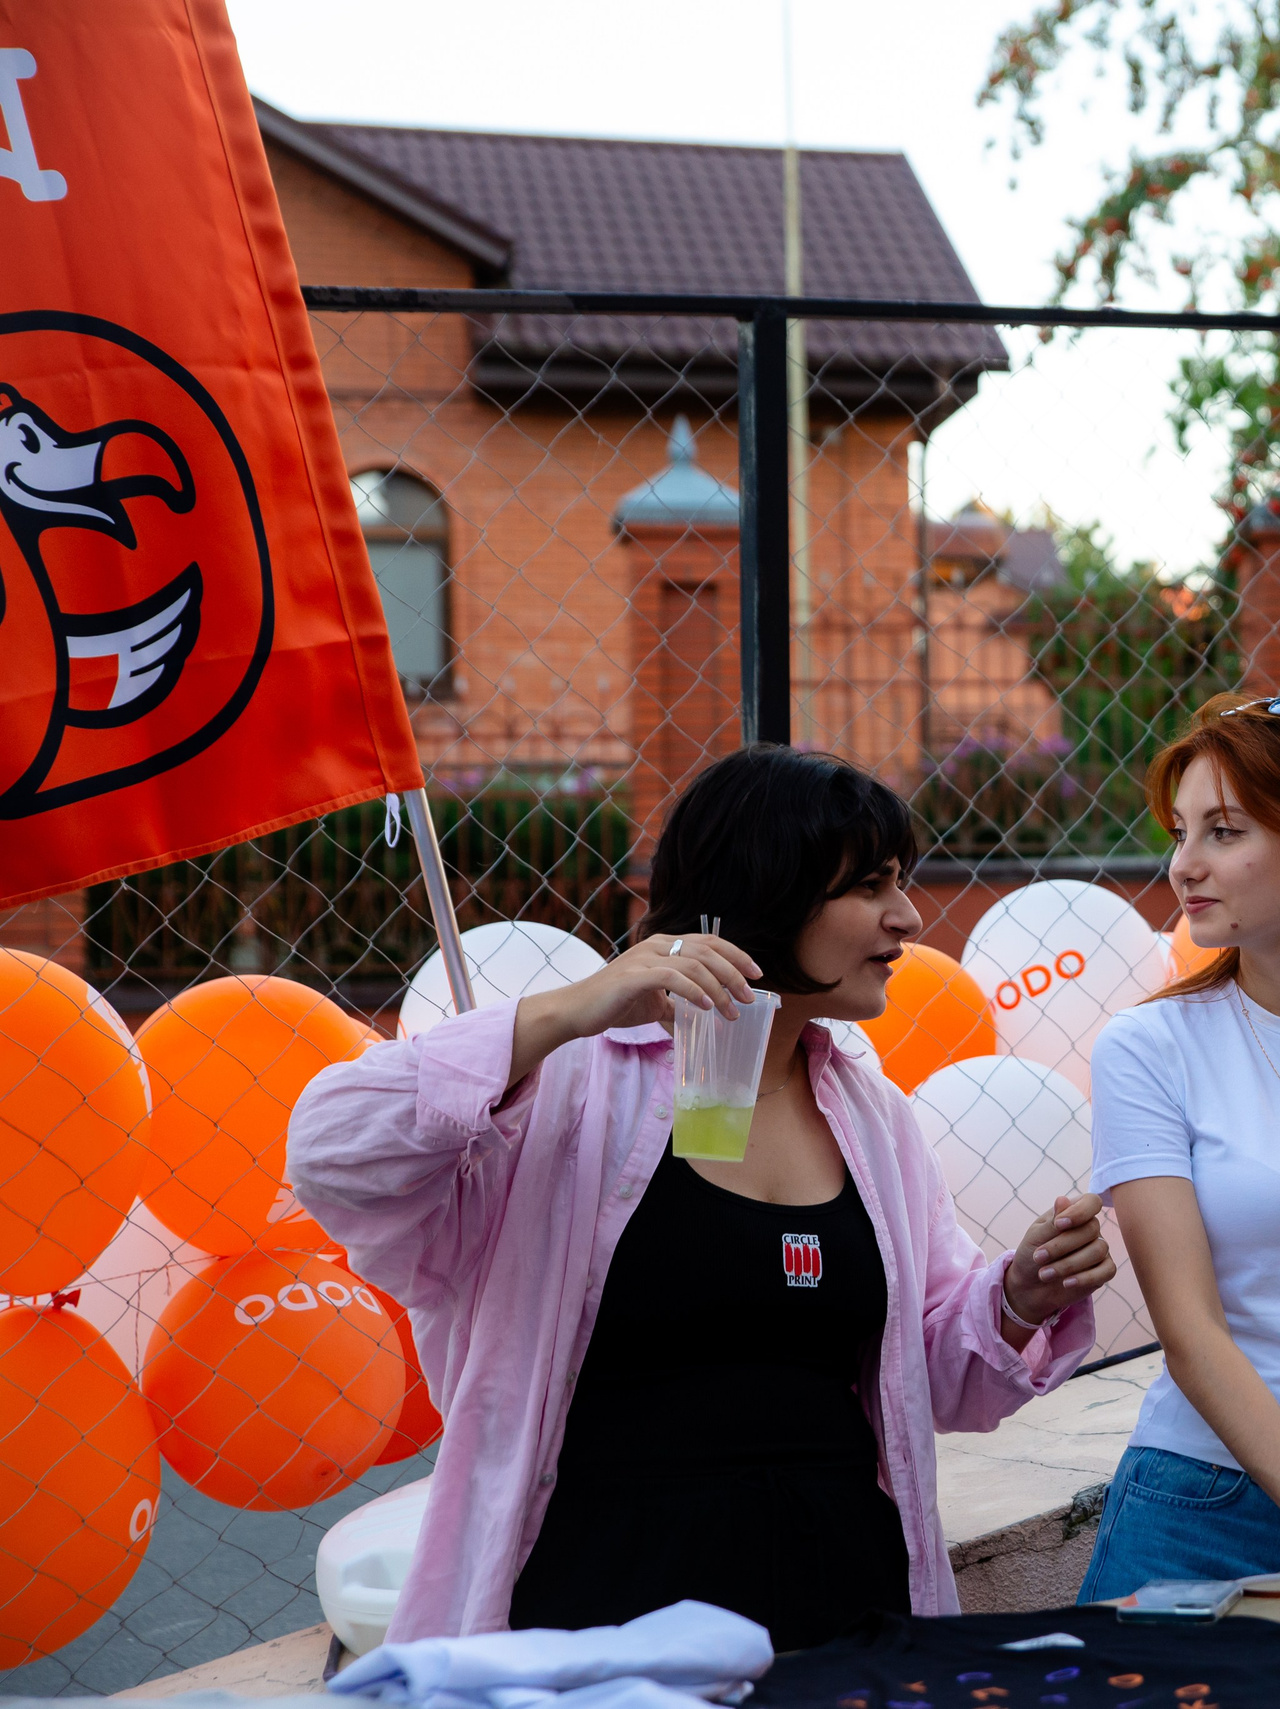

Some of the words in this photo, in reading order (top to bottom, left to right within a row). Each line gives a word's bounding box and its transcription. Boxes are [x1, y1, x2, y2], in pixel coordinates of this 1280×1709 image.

[987, 949, 1086, 1014] ODO
[783, 1235, 818, 1245] CIRCLE
[788, 1275, 817, 1285] PRINT
[234, 1280, 382, 1325] DODO
